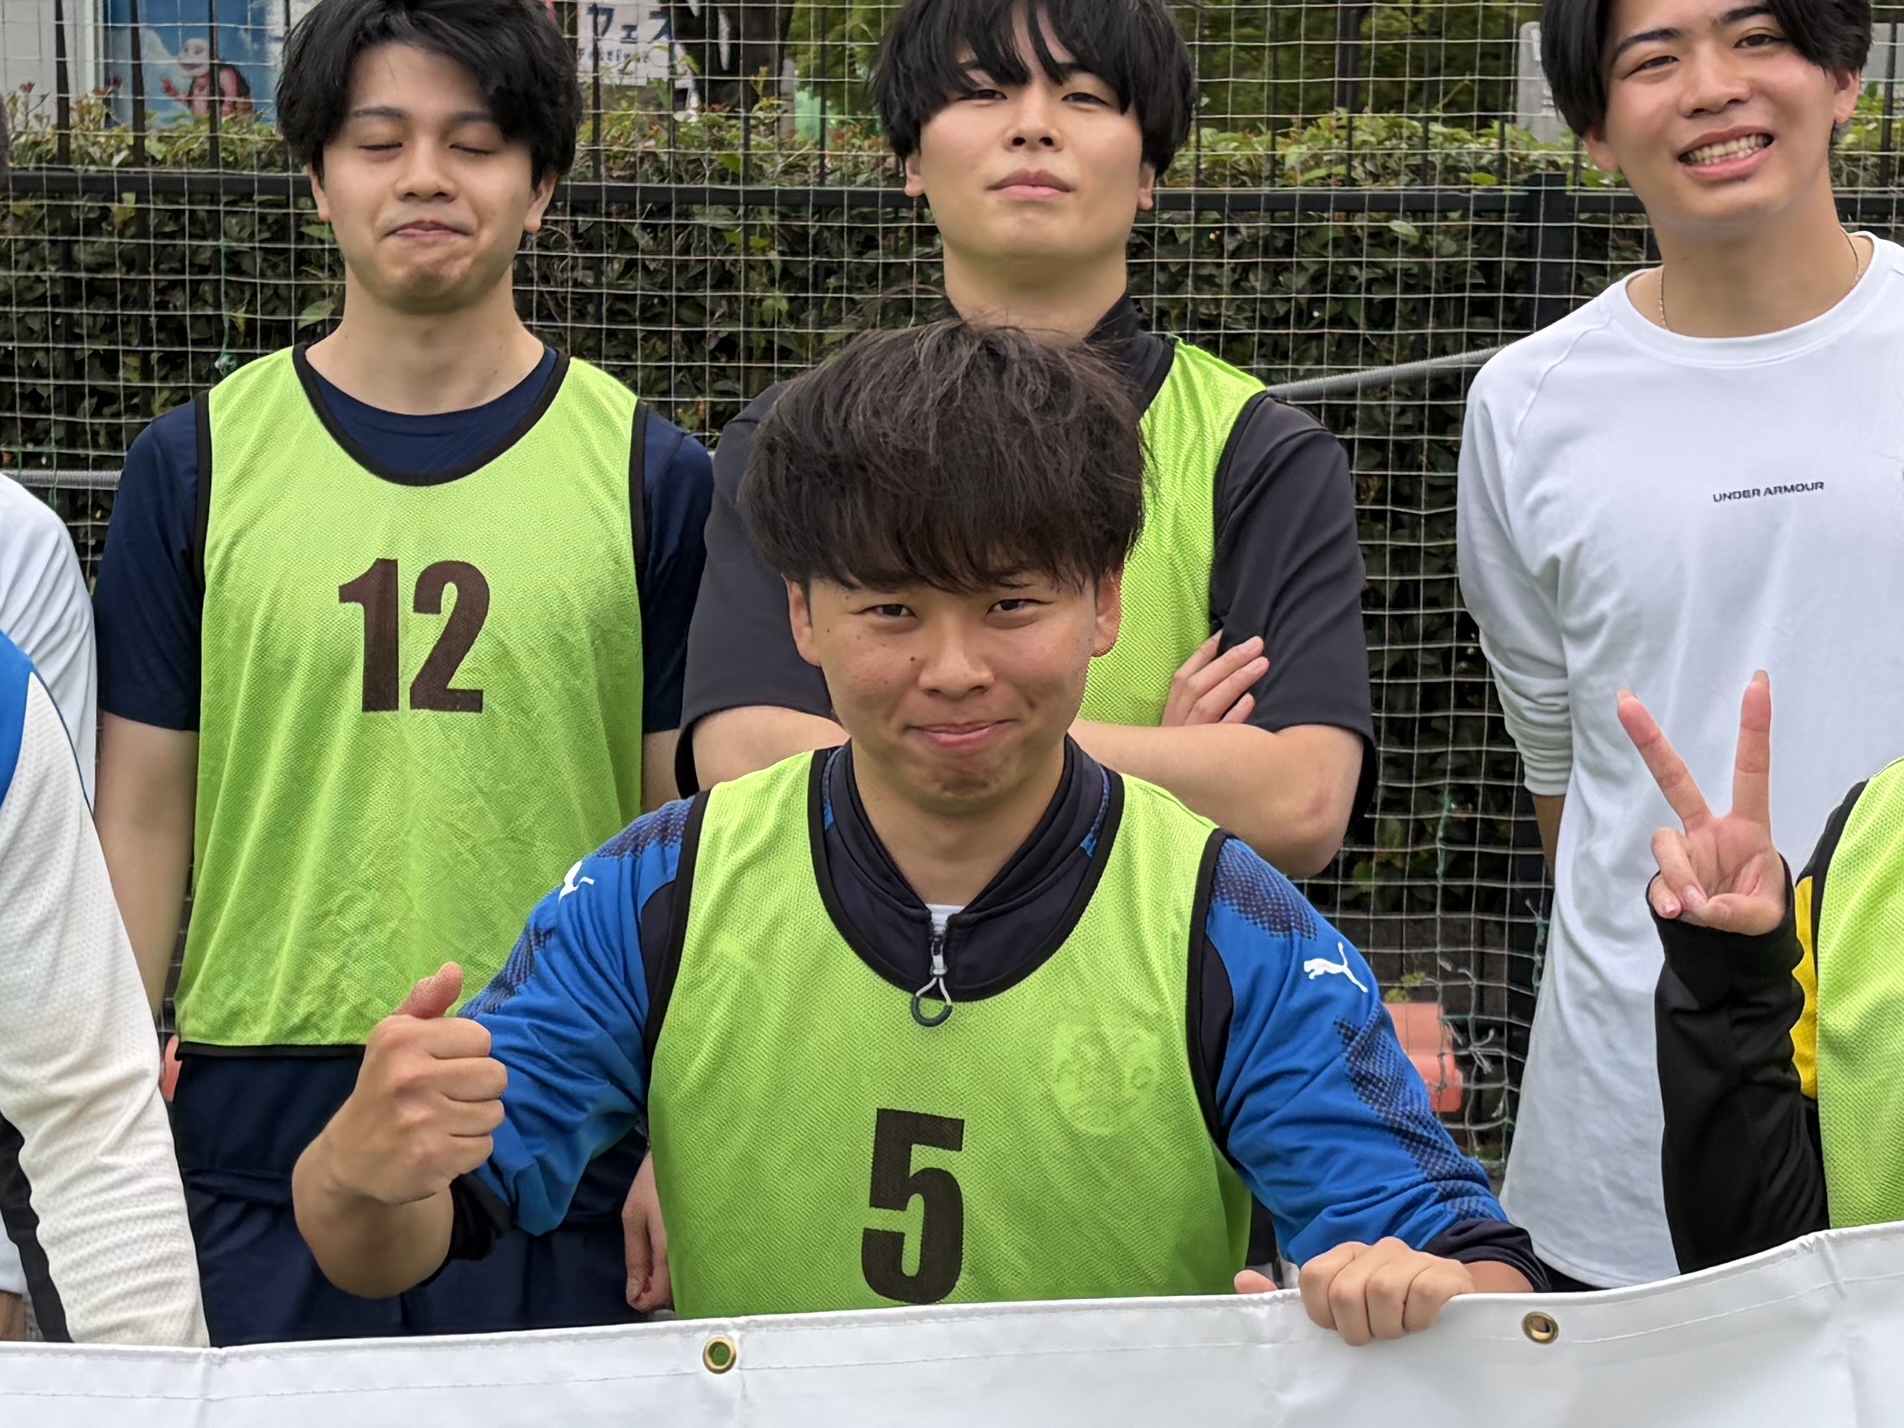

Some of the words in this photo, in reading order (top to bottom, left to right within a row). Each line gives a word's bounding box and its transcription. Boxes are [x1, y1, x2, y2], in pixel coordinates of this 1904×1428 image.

[1712, 488, 1761, 503] UNDER
[1763, 481, 1825, 497] ARMOUR
[338, 557, 491, 714] 12
[860, 1107, 965, 1305] 5
